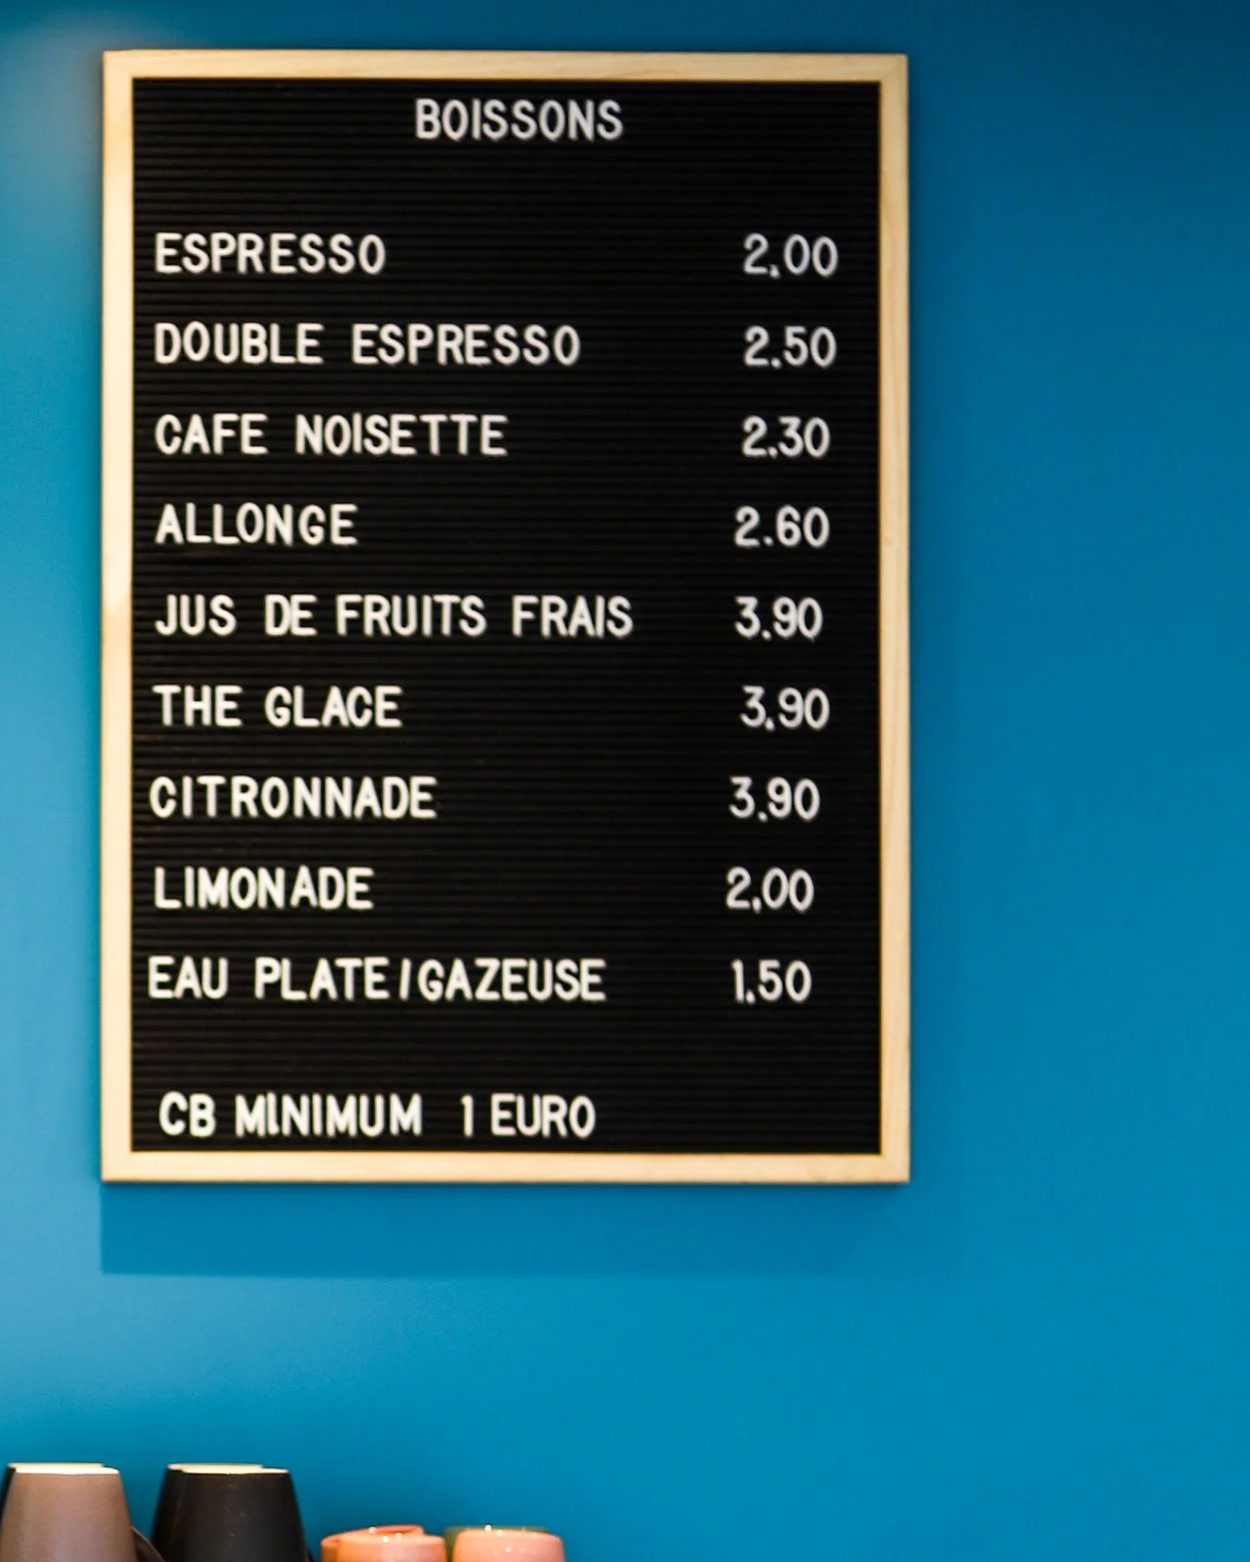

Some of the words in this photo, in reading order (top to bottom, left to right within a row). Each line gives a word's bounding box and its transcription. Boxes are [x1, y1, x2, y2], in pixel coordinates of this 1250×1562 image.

[415, 98, 623, 141] BOISSONS
[154, 232, 386, 275] ESPRESSO
[154, 320, 324, 365] DOUBLE
[351, 323, 580, 366] ESPRESSO
[154, 413, 268, 455] CAFE
[295, 412, 508, 456] NOISETTE
[154, 502, 358, 546] ALLONGE
[154, 594, 237, 636] JUS
[264, 594, 317, 636] DE
[335, 594, 487, 637] FRUITS
[512, 594, 633, 638] FRAIS
[151, 684, 242, 727] THE
[264, 685, 402, 728] GLACE
[148, 775, 437, 819] CITRONNADE
[154, 865, 374, 910] LIMONADE
[147, 955, 229, 999] EAU
[158, 1091, 216, 1138] CB
[234, 1092, 422, 1137] MINIMUM
[460, 1094, 474, 1137] 1
[490, 1093, 596, 1138] EURO
